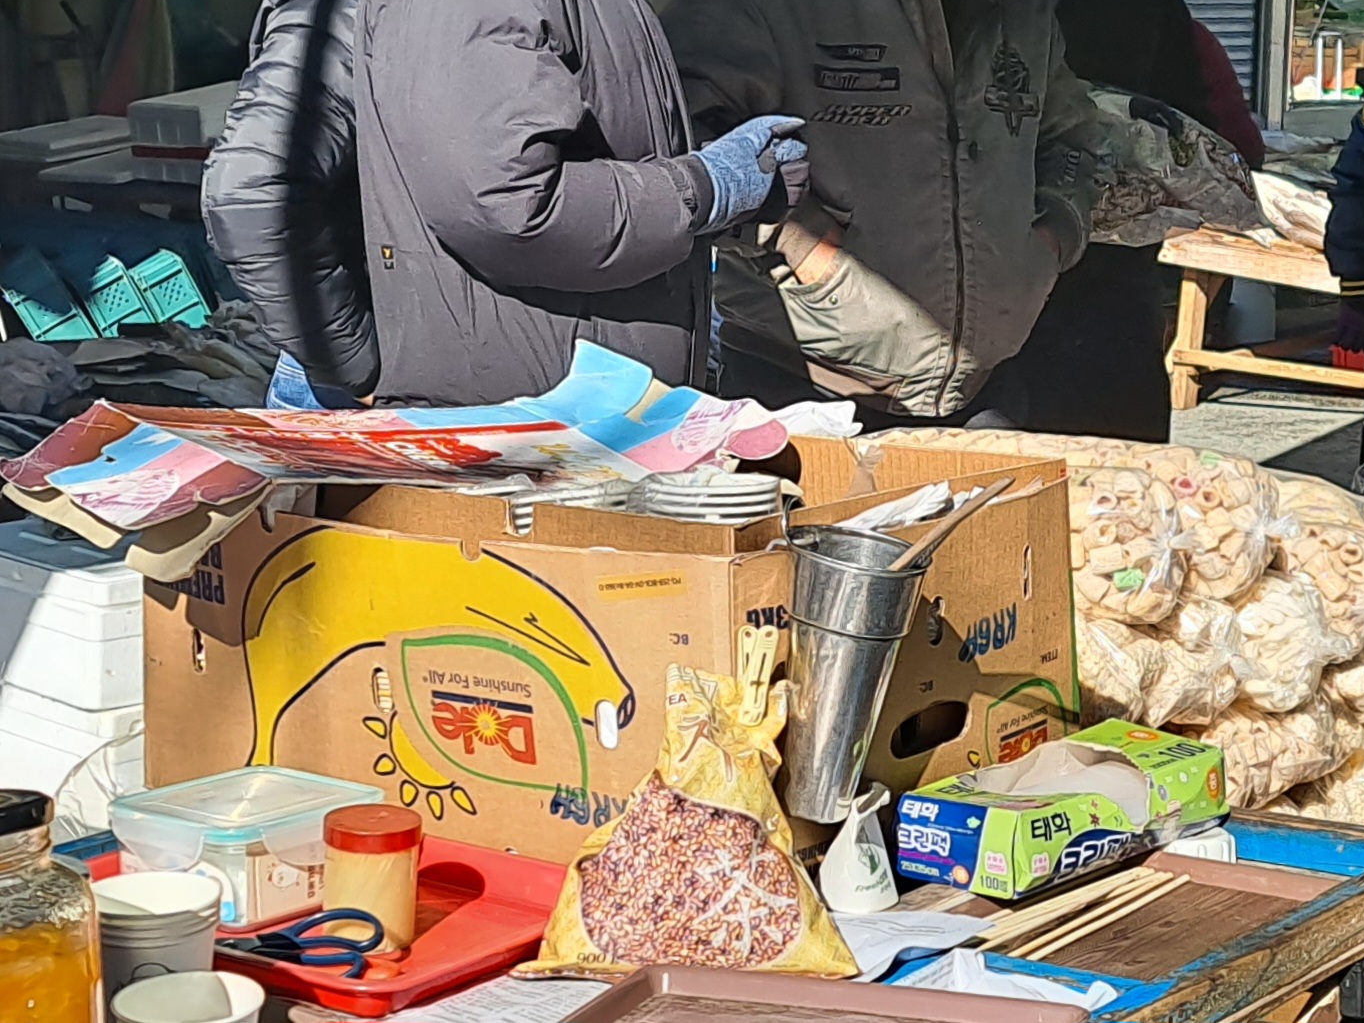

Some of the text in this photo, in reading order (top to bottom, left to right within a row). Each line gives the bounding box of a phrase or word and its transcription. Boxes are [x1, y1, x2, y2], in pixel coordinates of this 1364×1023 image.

[447, 673, 470, 689] For
[472, 676, 532, 698] Sunshine
[666, 692, 688, 707] EA
[431, 702, 537, 765] Dole
[902, 799, 940, 822] 태화
[1030, 811, 1073, 842] 태화
[898, 823, 951, 857] 크린팩
